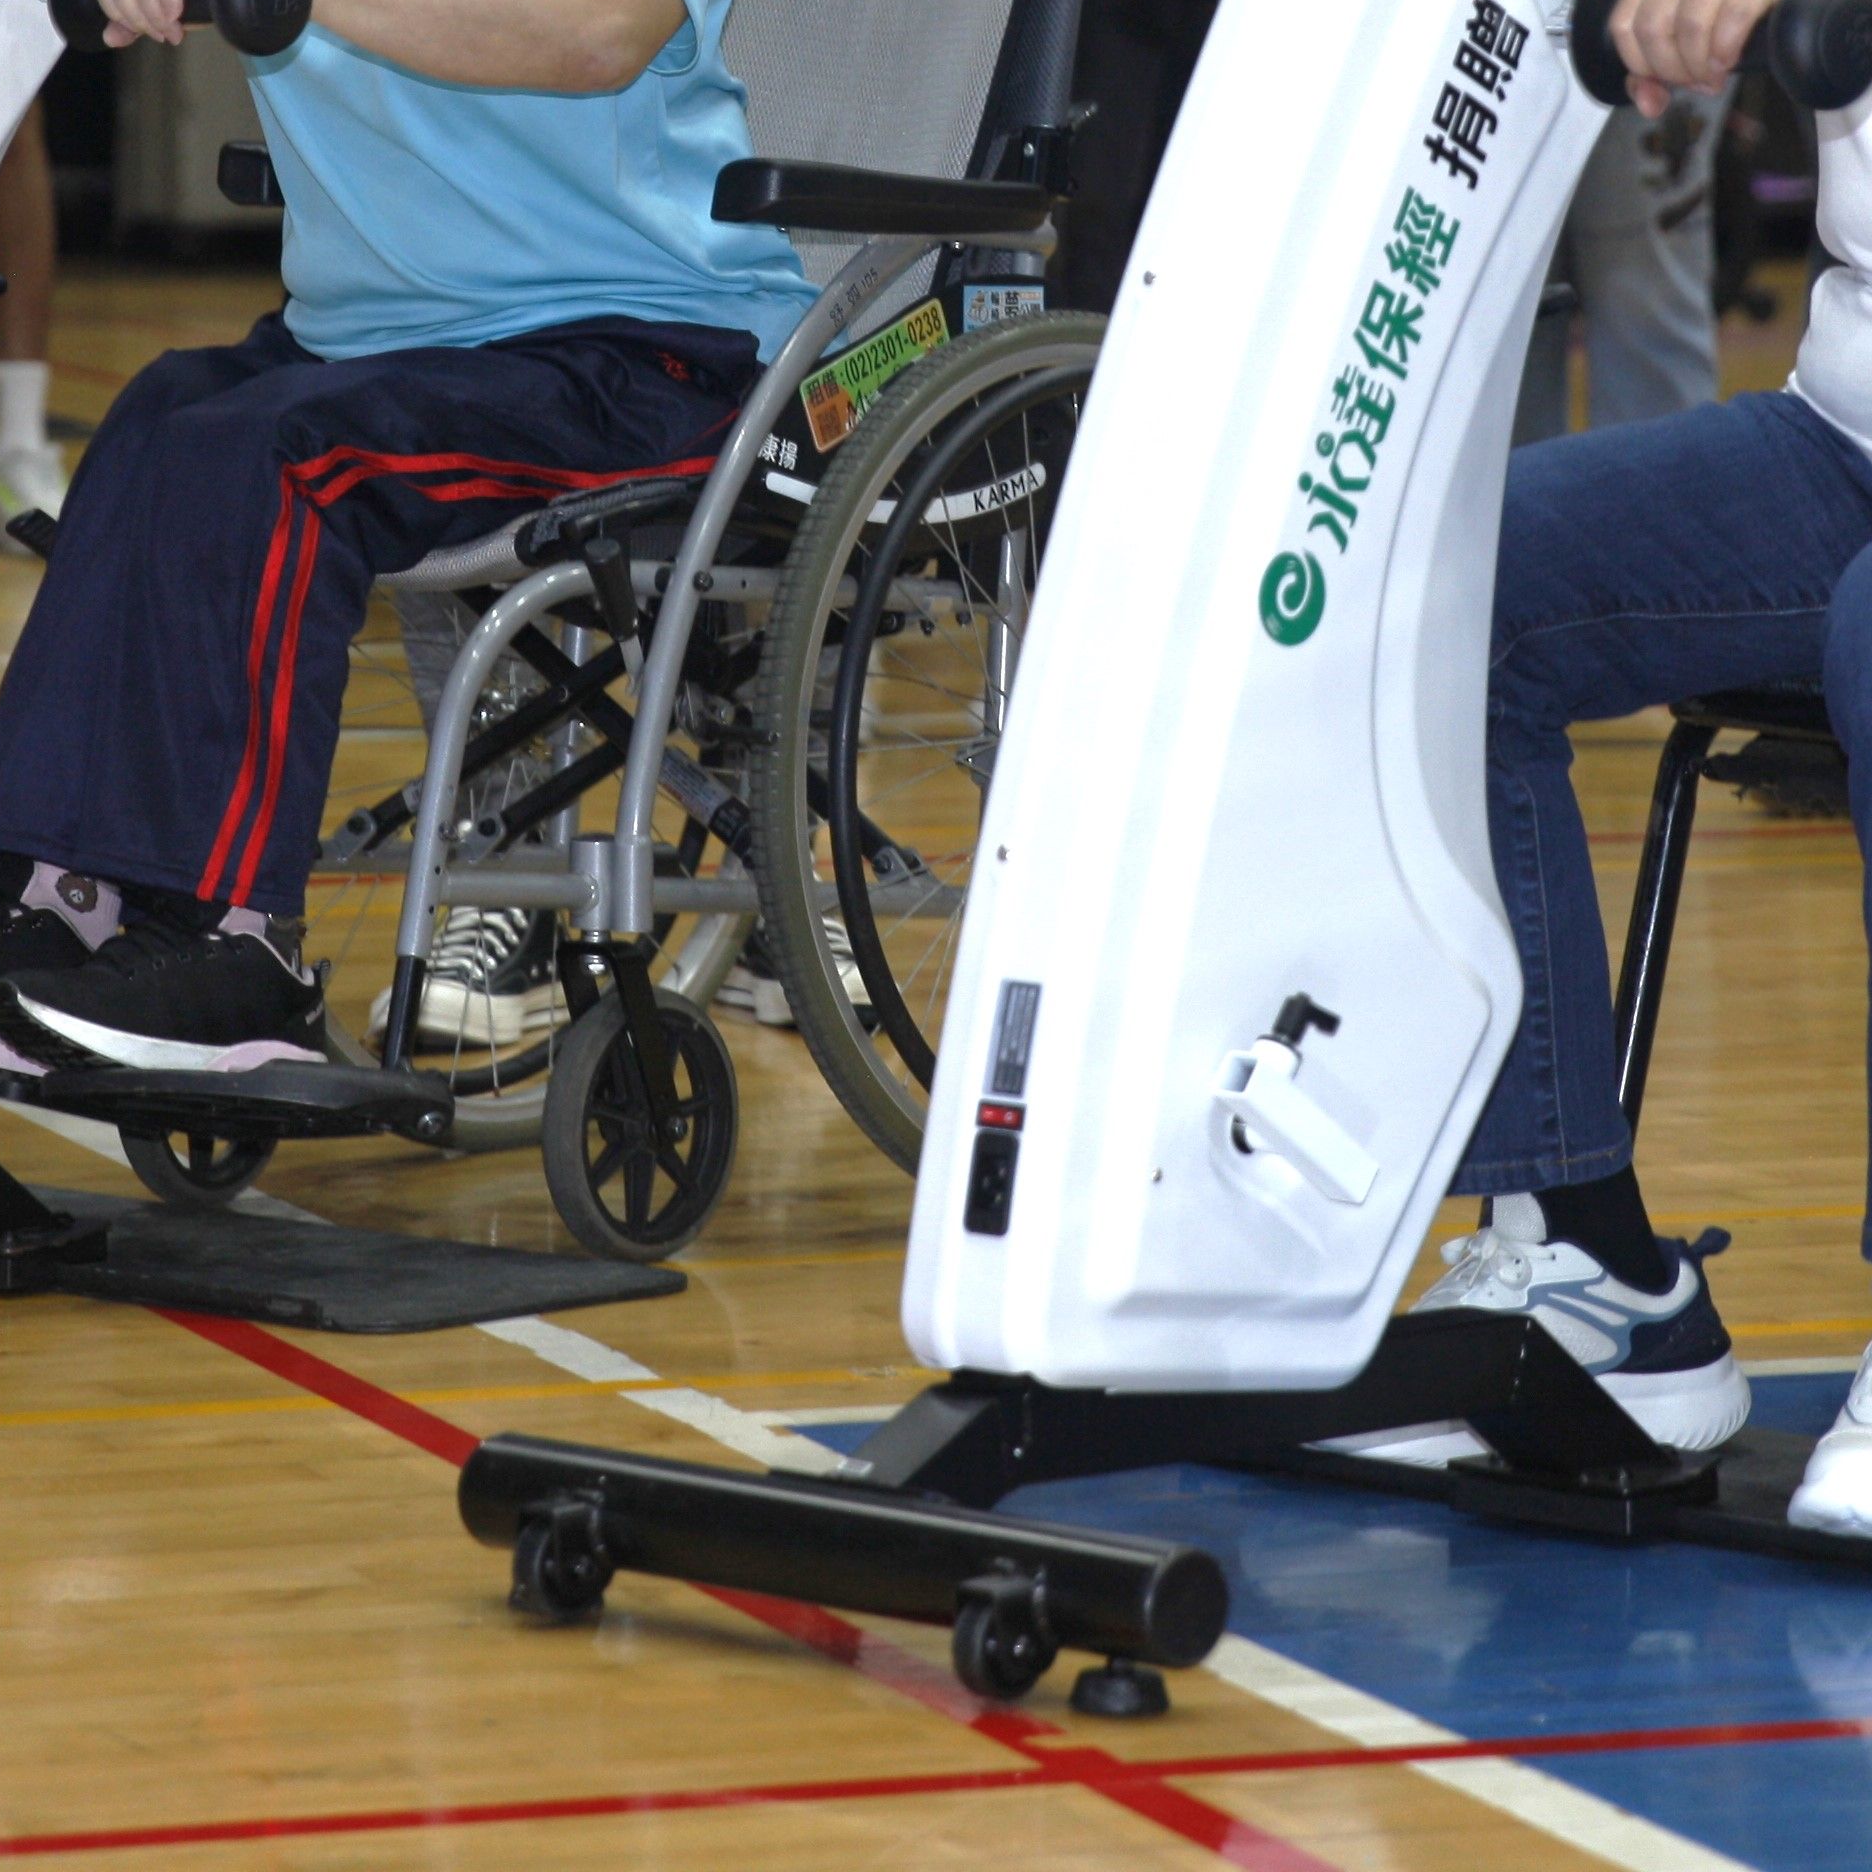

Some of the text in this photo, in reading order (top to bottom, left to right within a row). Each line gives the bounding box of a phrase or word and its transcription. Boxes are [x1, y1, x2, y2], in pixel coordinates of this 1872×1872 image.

[1299, 185, 1460, 553] 永達保經
[973, 468, 1040, 513] KARMA
